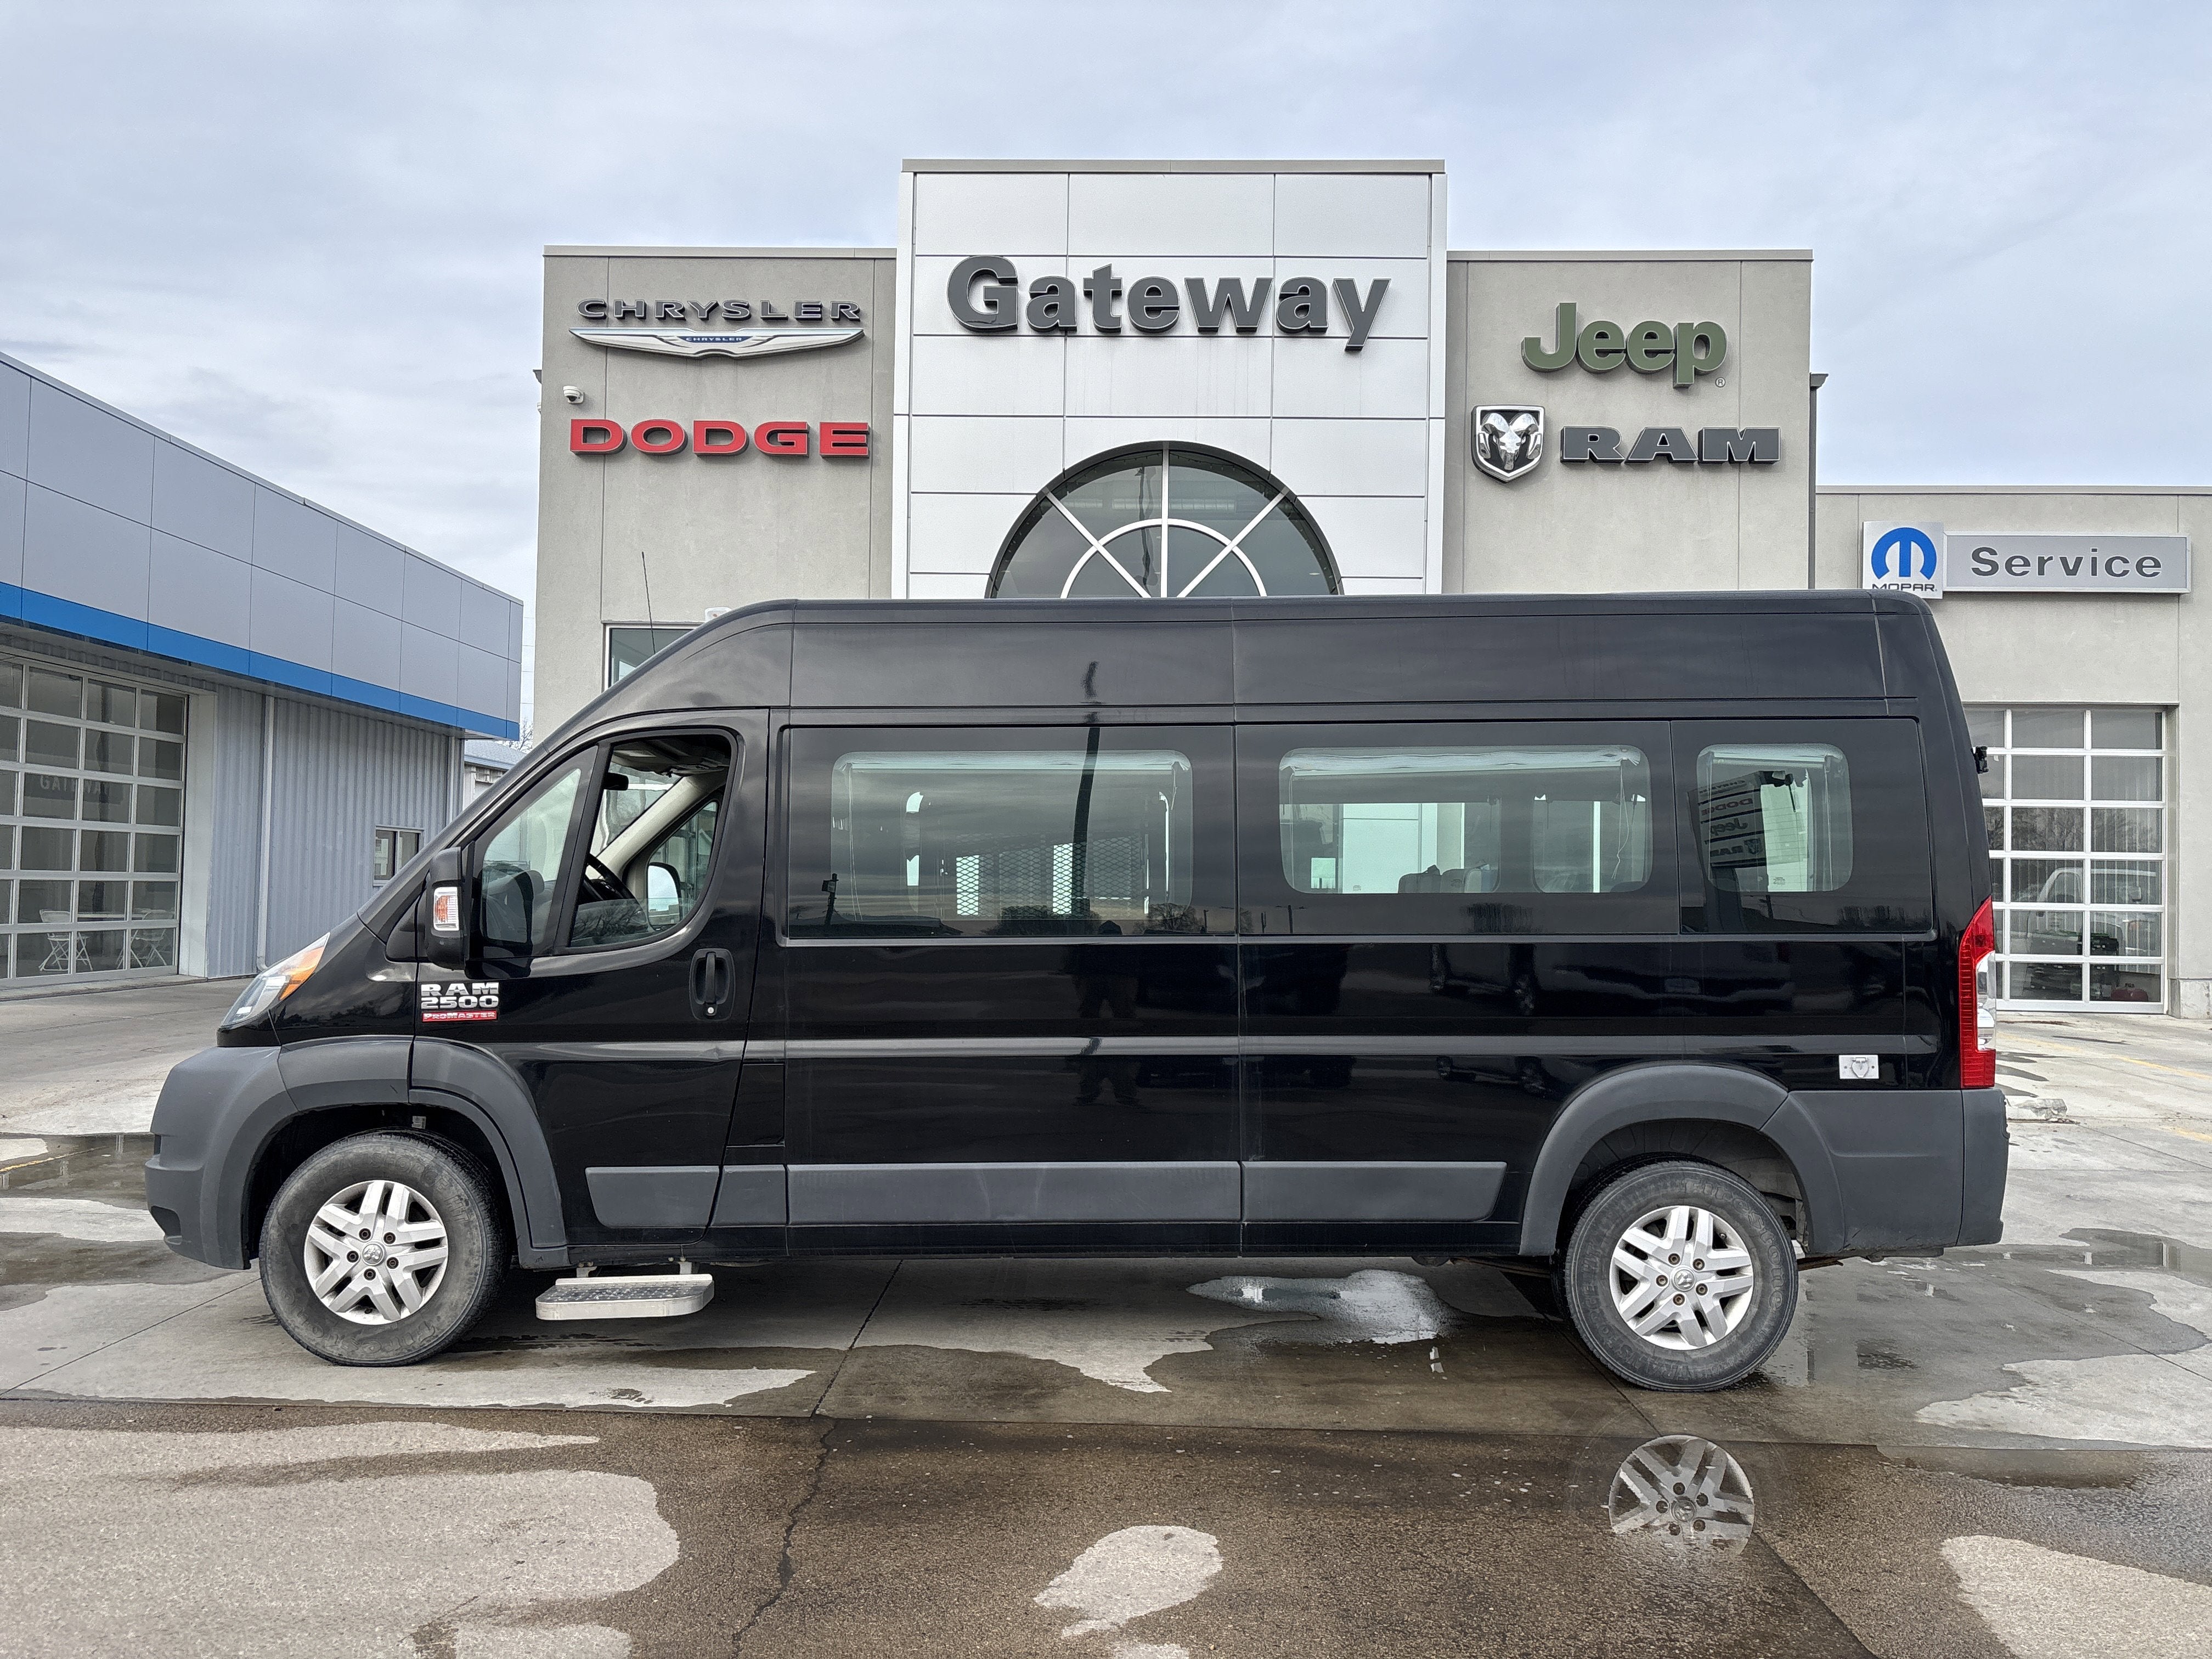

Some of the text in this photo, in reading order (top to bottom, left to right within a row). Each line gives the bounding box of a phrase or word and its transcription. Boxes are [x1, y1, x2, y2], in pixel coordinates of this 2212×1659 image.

[577, 298, 861, 320] CHRYSLER
[946, 255, 1391, 351] Gateway
[1521, 302, 1728, 389] Jeep
[570, 419, 870, 459] DODGE
[1560, 426, 1781, 464] RAM
[1971, 546, 2163, 578] Service
[1872, 583, 1935, 592] MOPAR
[421, 983, 499, 996] RAM
[421, 995, 499, 1009] 2500
